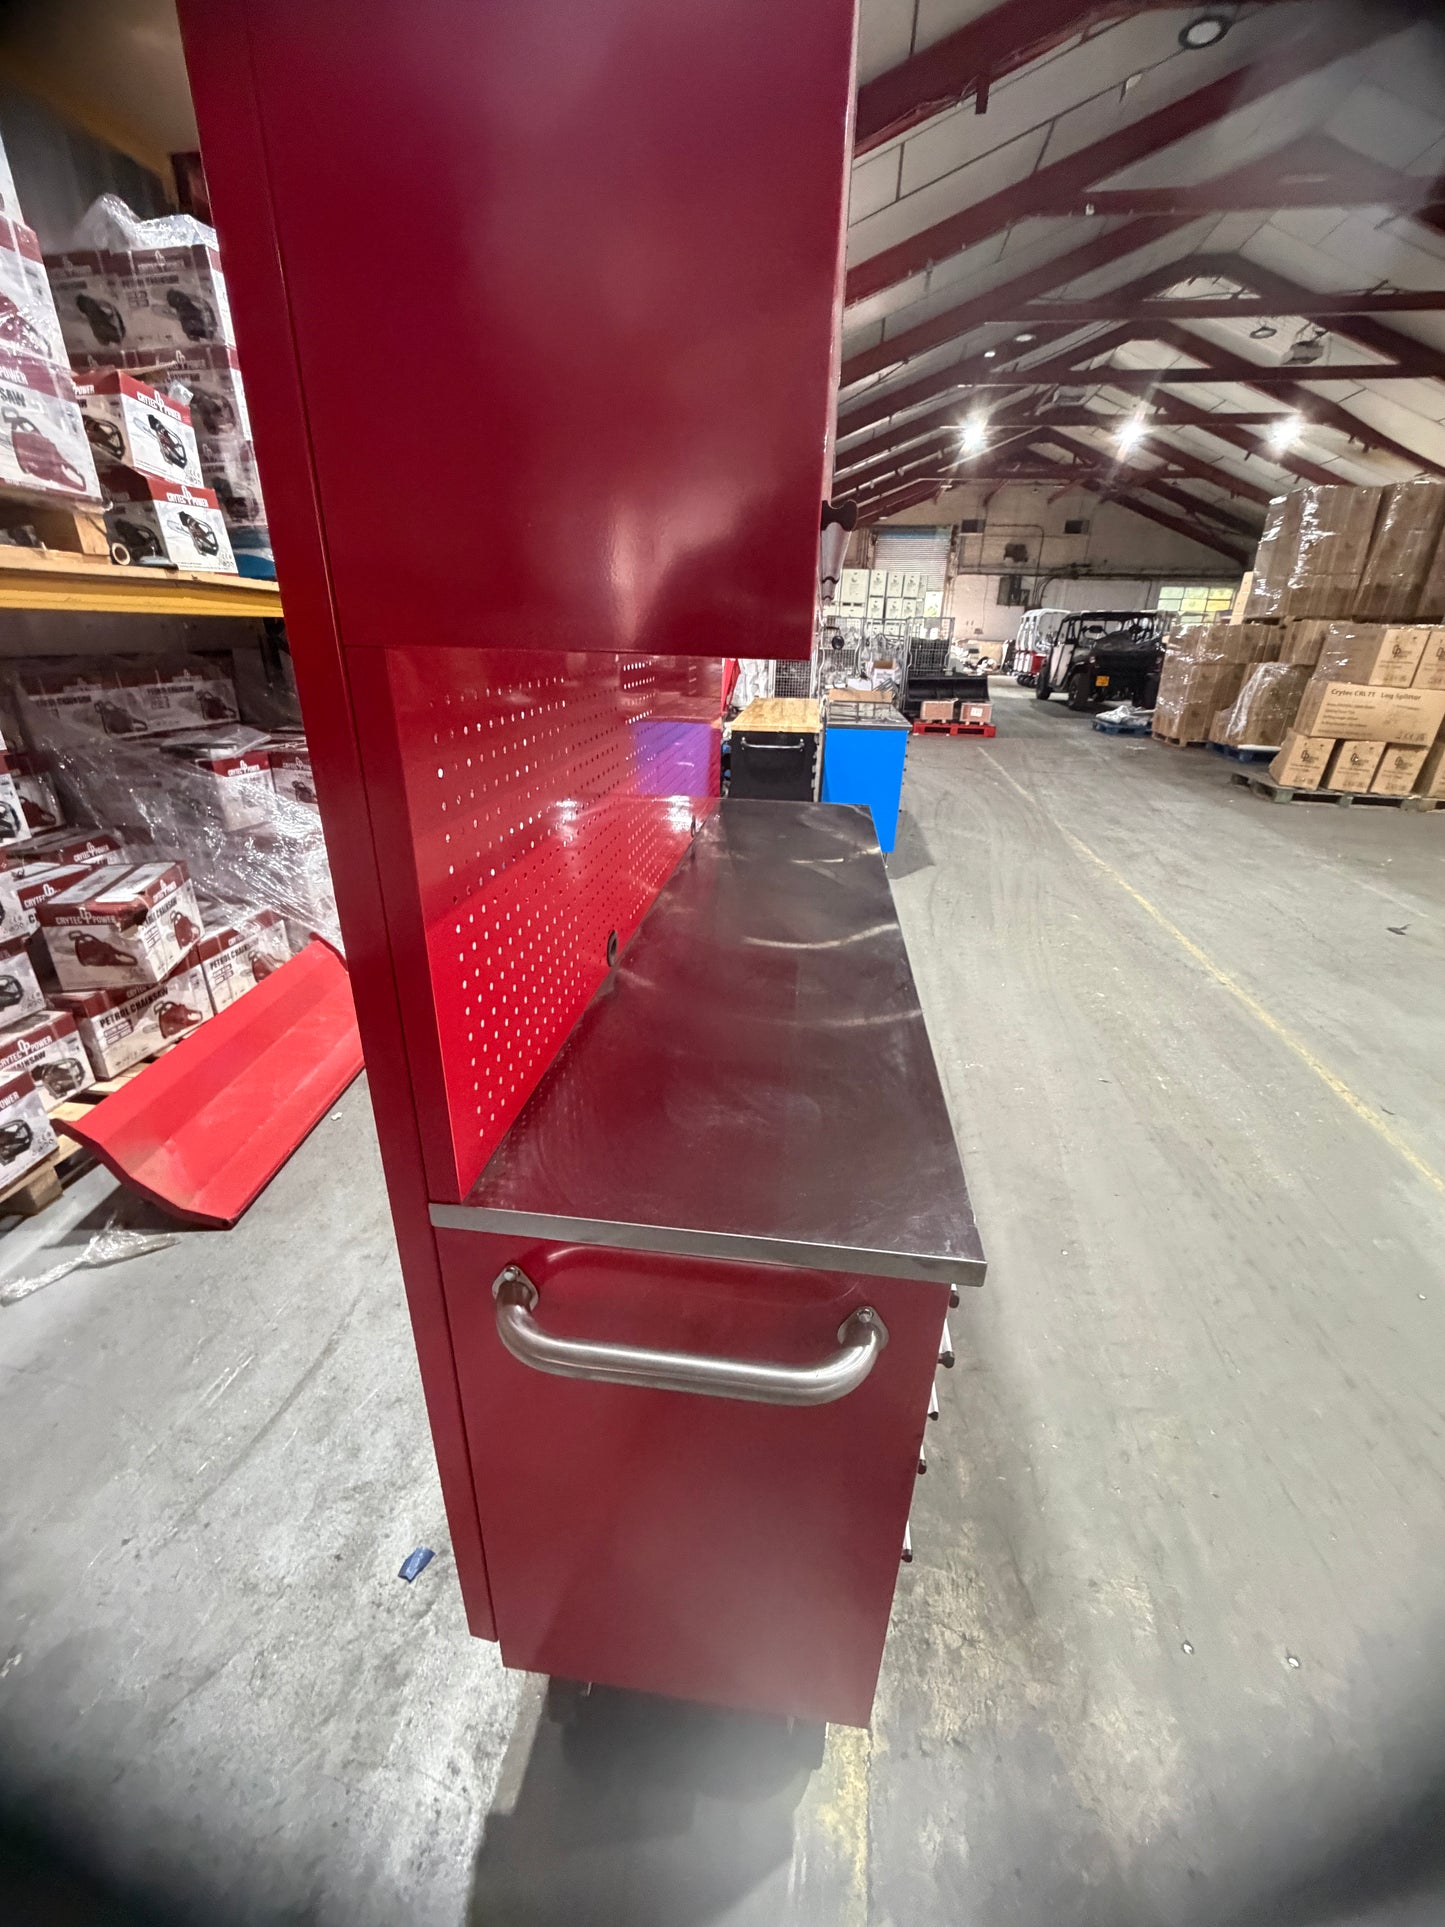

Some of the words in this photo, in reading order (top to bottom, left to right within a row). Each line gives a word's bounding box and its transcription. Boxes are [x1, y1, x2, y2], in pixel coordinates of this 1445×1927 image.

[1330, 688, 1353, 697] Crytec
[55, 916, 83, 925] CRYTEC
[92, 914, 117, 925] POWER
[210, 953, 231, 970] PETROL
[99, 1008, 130, 1028] PETROL
[130, 987, 169, 1014] CHAINSAW
[30, 1035, 53, 1051] POWER
